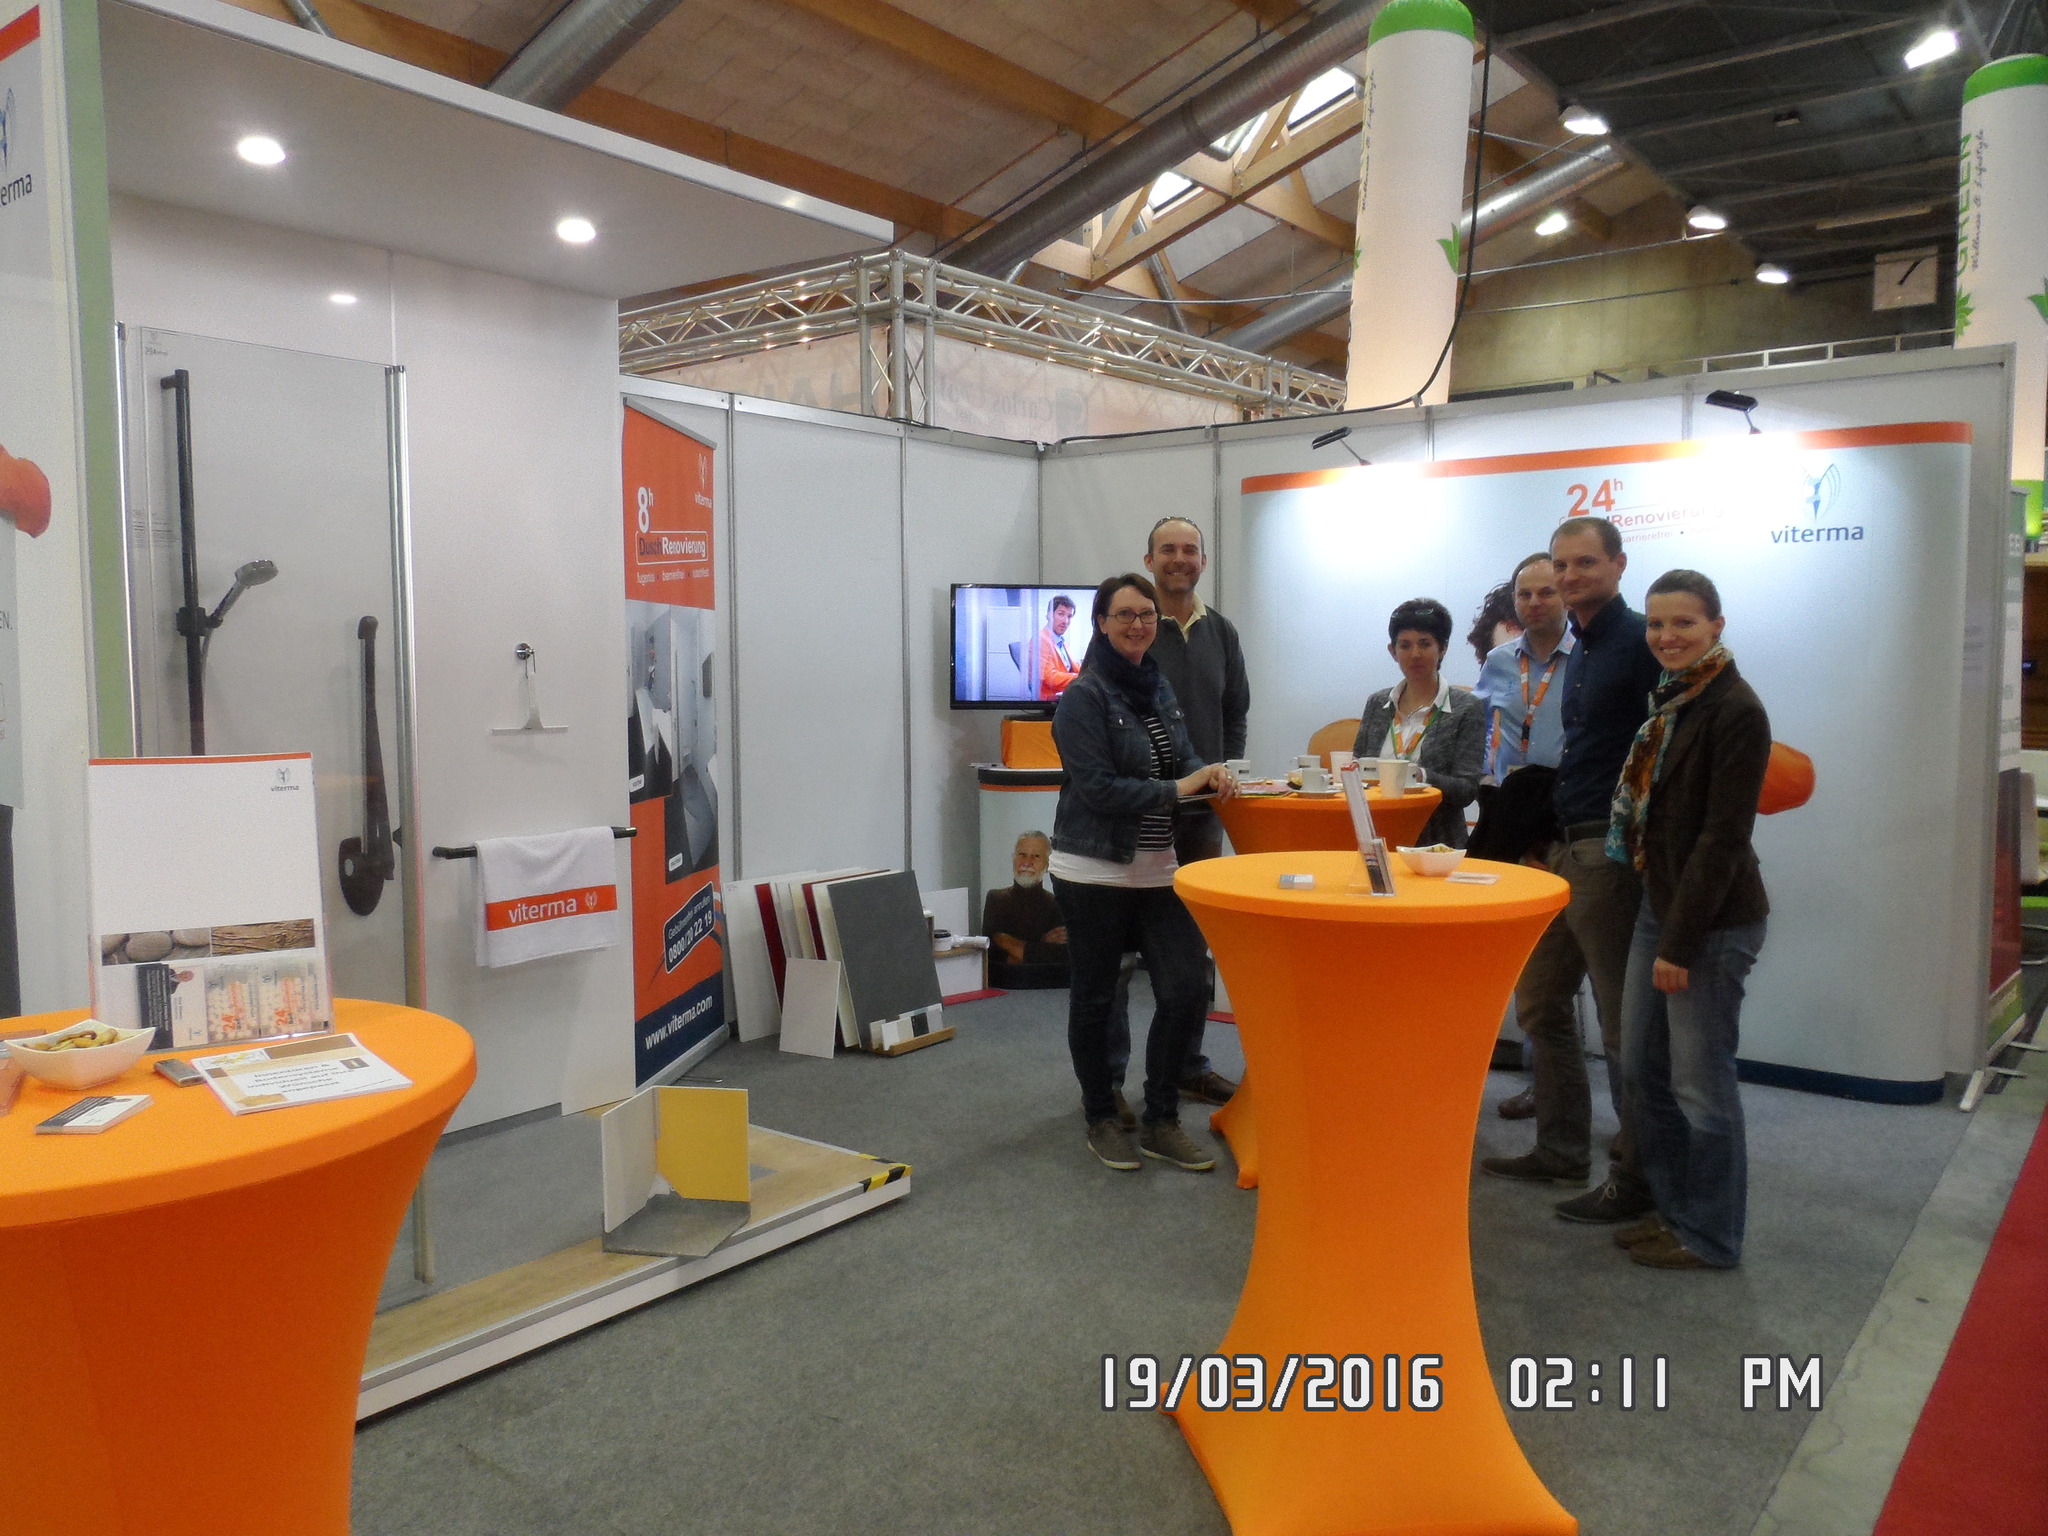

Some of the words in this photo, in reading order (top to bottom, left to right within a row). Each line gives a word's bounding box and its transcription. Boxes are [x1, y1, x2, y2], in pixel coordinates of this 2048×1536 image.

[0, 173, 32, 206] erma
[637, 486, 655, 534] 8h
[1566, 478, 1624, 518] 24h
[1606, 503, 1725, 530] Renovierung
[1770, 525, 1864, 543] viterma
[508, 897, 578, 923] viterma
[693, 917, 703, 937] 22
[704, 909, 713, 927] 19
[645, 995, 713, 1050] www.viterma.com
